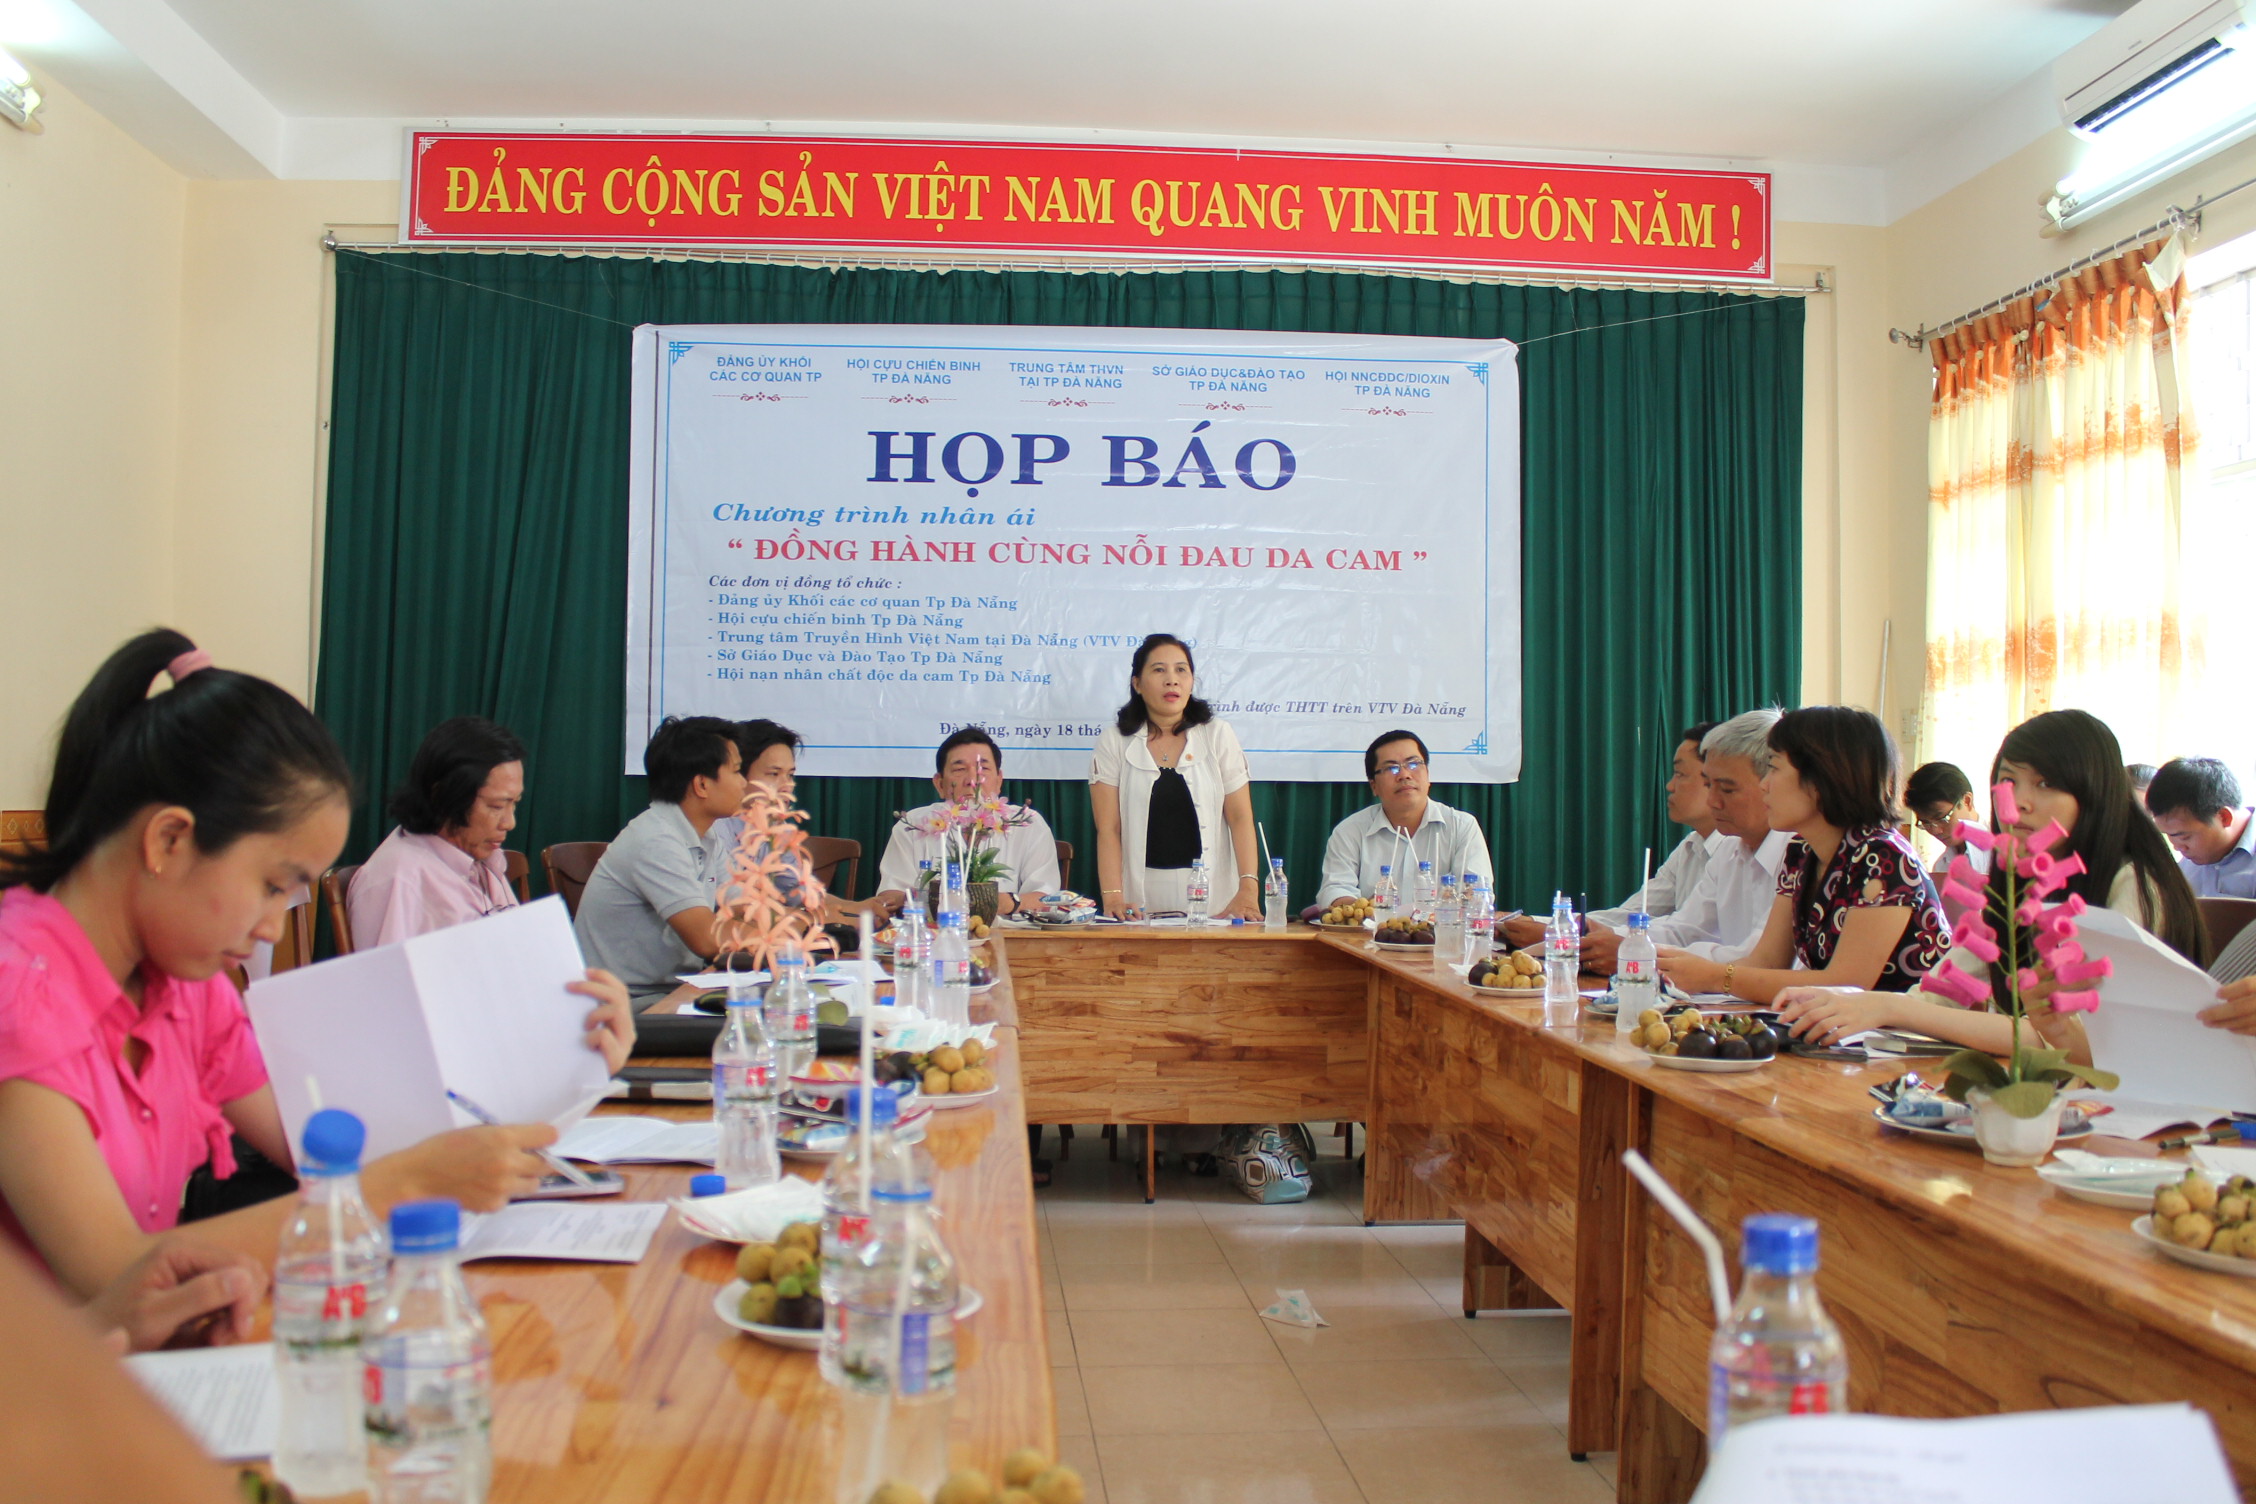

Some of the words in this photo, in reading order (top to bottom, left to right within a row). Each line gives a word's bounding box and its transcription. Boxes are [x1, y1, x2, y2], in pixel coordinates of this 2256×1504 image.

[443, 148, 586, 213] ĐẢNG
[602, 156, 742, 227] CỘNG
[758, 151, 858, 217] SẢN
[872, 161, 989, 232] VIỆT
[1003, 177, 1115, 223] NAM
[1130, 180, 1303, 236] QUANG
[1317, 187, 1438, 235] VINH
[1453, 183, 1597, 242] MUÔN
[1610, 189, 1715, 248] NĂM
[716, 355, 754, 367] ĐẢNG
[757, 355, 776, 367] ỦY
[779, 356, 811, 367] KHỐI
[846, 358, 869, 368] HỘI
[873, 360, 902, 371] CỰU
[906, 359, 945, 370] CHIẾN
[949, 361, 980, 371] BINH
[1008, 362, 1054, 373] TRUNG
[1057, 362, 1085, 373] TÂM
[1088, 364, 1123, 374] THVN
[709, 369, 736, 381] CÁC
[740, 371, 761, 381] CƠ
[764, 372, 801, 382] QUAN
[805, 372, 822, 382] TP
[871, 373, 888, 383] TP
[890, 373, 909, 383] ĐÀ
[1151, 364, 1172, 376] SỞ
[1174, 366, 1207, 378] GIÁO
[1279, 369, 1306, 382] TẠO
[1325, 371, 1347, 382] HỘI
[1018, 376, 1040, 389] TẠI
[1042, 377, 1059, 386] TP
[1062, 376, 1081, 387] ĐÀ
[1188, 381, 1205, 390] TP
[1208, 380, 1226, 391] ĐÀ
[1354, 385, 1370, 395] TP
[1372, 384, 1391, 396] ĐÀ
[866, 431, 1070, 498] HỌP
[1100, 420, 1296, 490] BÁO
[712, 503, 825, 526] Chương
[834, 506, 908, 523] trình
[920, 507, 995, 524] nhân
[1006, 508, 1035, 525] ái
[753, 528, 858, 560] ĐỒNG
[869, 535, 976, 562] HÀNH
[988, 536, 1090, 564] CÙNG
[1102, 534, 1167, 565] NỖI
[1179, 546, 1254, 567] ĐAU
[1265, 548, 1314, 568] DA
[1325, 549, 1402, 570] CAM
[708, 575, 736, 586] Các
[741, 576, 769, 587] đơn
[775, 576, 789, 590] vị
[793, 575, 832, 590] đồng
[836, 576, 853, 588] tổ
[856, 577, 892, 588] chức
[718, 594, 758, 608] Đảng
[763, 594, 782, 608] ủy
[787, 594, 823, 606] Khối
[828, 595, 855, 606] các
[859, 597, 878, 606] cơ
[881, 599, 919, 609] quan
[925, 596, 945, 610] Tp
[950, 597, 971, 608] Đà
[976, 596, 1018, 611] Nẵng
[717, 612, 744, 625] Hội
[749, 614, 778, 626] cựu
[783, 612, 825, 624] chiến
[831, 613, 865, 624] binh
[870, 614, 891, 628] Tp
[896, 614, 917, 625] Đà
[922, 613, 963, 629] Nẵng
[717, 631, 764, 645] Trung
[768, 632, 798, 642] tâm
[803, 630, 859, 646] Truyền
[865, 632, 902, 643] Hình
[907, 633, 939, 646] Việt
[944, 633, 979, 644] Nam
[984, 634, 1005, 645] tại
[1011, 634, 1031, 645] Đà
[1036, 633, 1078, 649] Nẵng
[1083, 635, 1121, 646] (VTV
[717, 649, 736, 660] Sở
[740, 649, 777, 661] Giáo
[782, 650, 812, 664] Dục
[817, 651, 835, 661] và
[841, 651, 871, 662] Đào
[876, 651, 906, 665] Tạo
[910, 651, 930, 665] Tp
[935, 652, 956, 663] Đà
[962, 651, 1003, 666] Nẵng
[717, 668, 743, 681] Hội
[749, 671, 779, 682] nạn
[783, 668, 822, 679] nhân
[827, 668, 862, 680] chất
[866, 669, 894, 682] độc
[899, 669, 917, 681] da
[922, 673, 953, 681] cam
[958, 670, 979, 684] Tp
[984, 671, 1005, 682] Đà
[1010, 670, 1052, 685] Nẵng
[1206, 700, 1240, 712] rình
[1244, 701, 1280, 715] được
[1286, 702, 1328, 713] THTT
[1332, 703, 1362, 713] trên
[1367, 703, 1398, 714] VTV
[1401, 703, 1422, 714] Đà
[1426, 702, 1466, 717] Nẵng
[1015, 724, 1051, 738] ngày
[1057, 725, 1072, 735] 18
